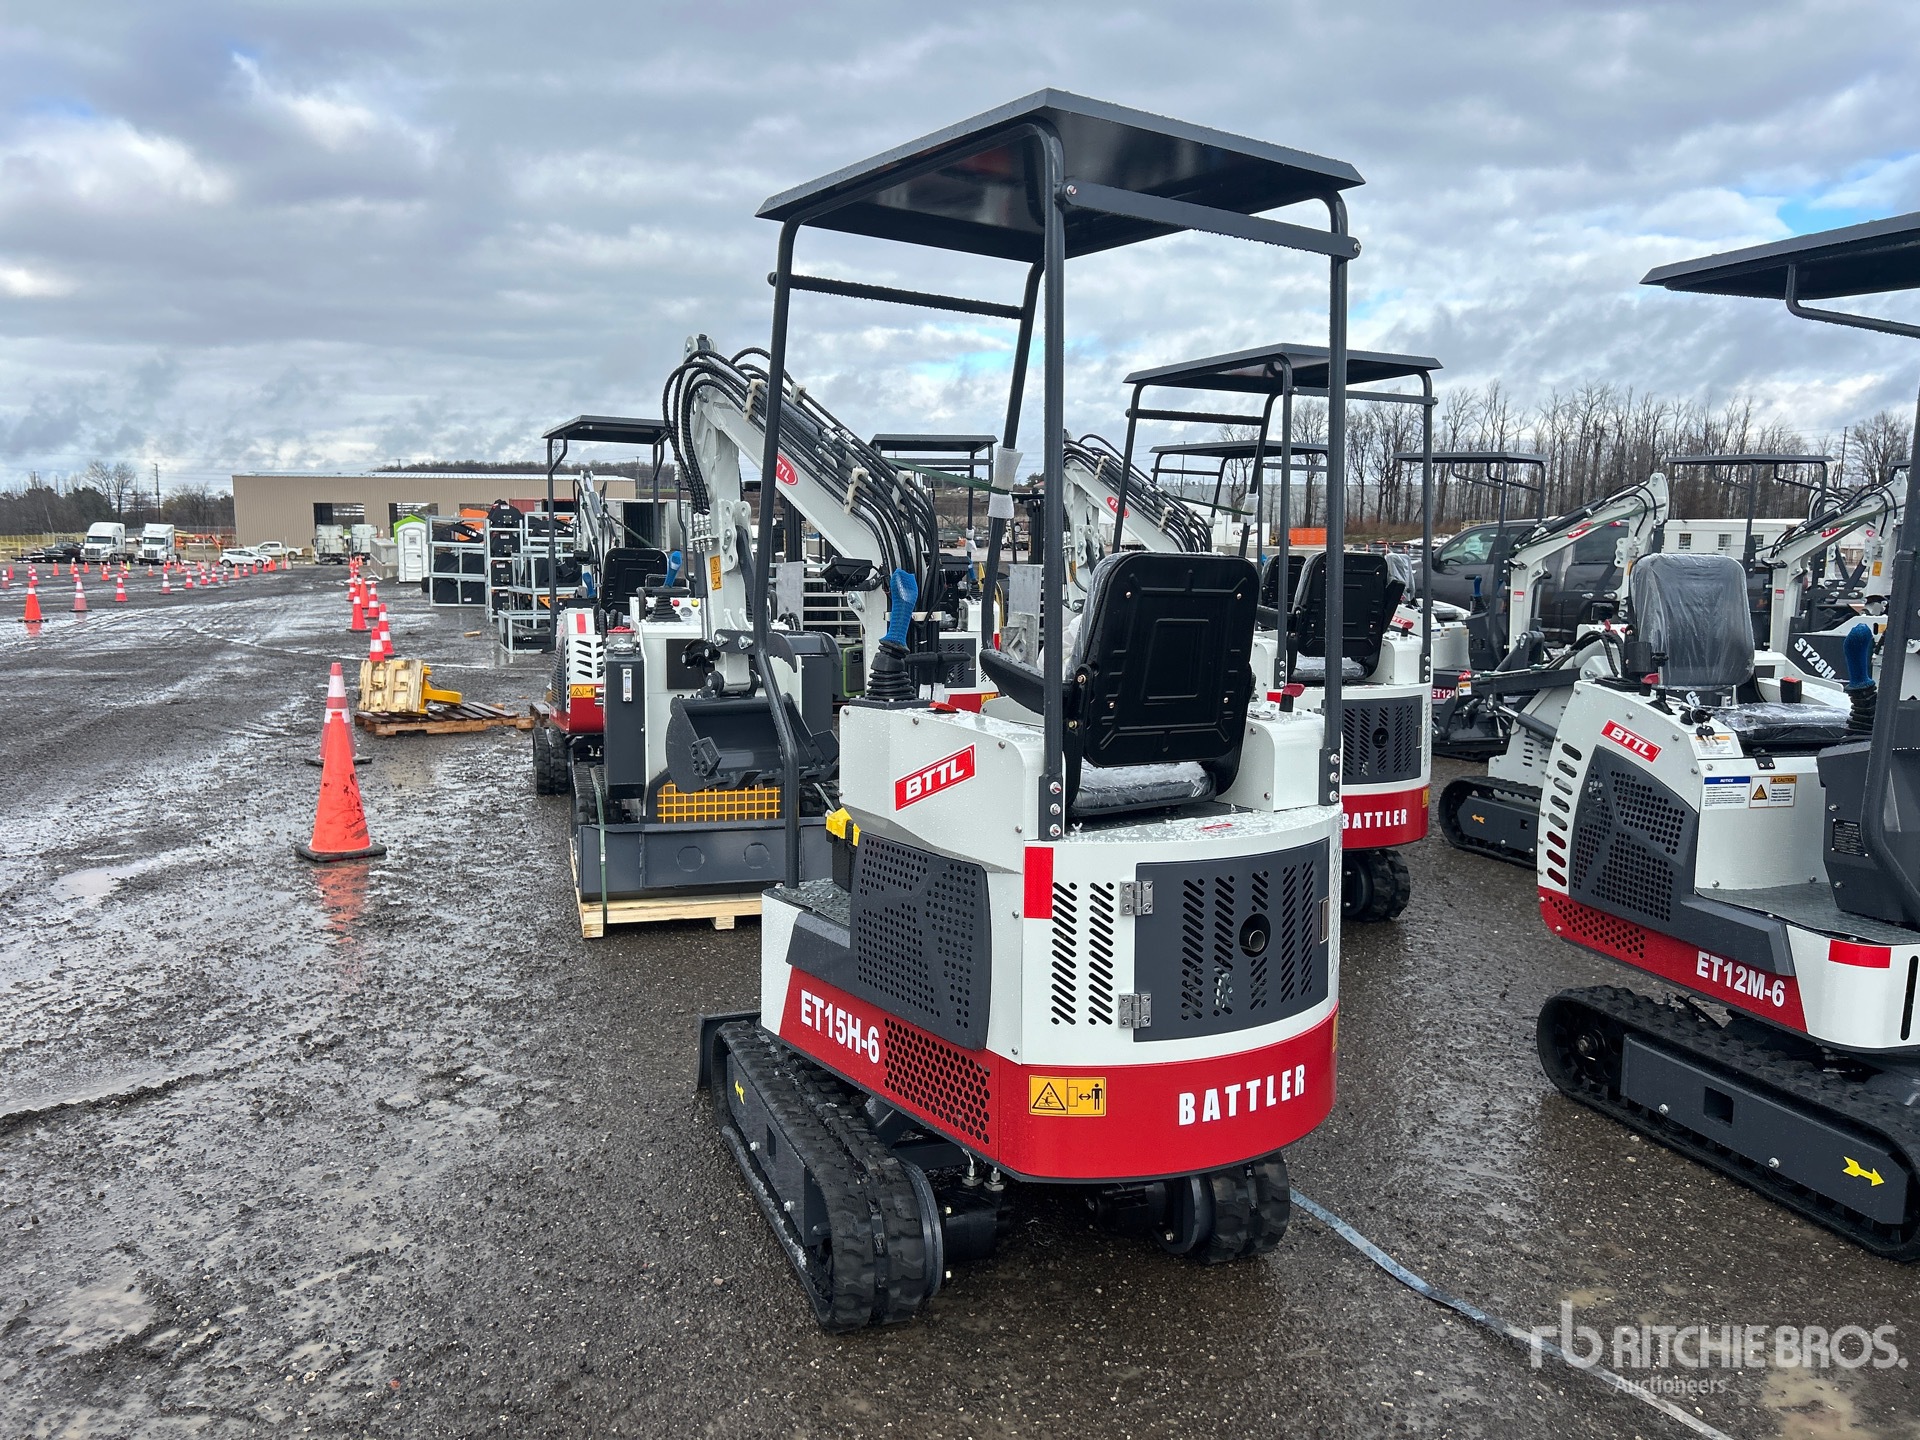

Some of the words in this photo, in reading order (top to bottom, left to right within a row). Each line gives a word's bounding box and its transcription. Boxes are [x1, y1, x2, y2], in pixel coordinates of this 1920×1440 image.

[1609, 726, 1650, 756] BTTL
[905, 758, 965, 801] BTTL
[1342, 808, 1407, 829] BATTLER
[1696, 950, 1785, 1007] ET12M-6
[801, 989, 880, 1064] ET15H-6
[1178, 1064, 1305, 1126] BATTLER
